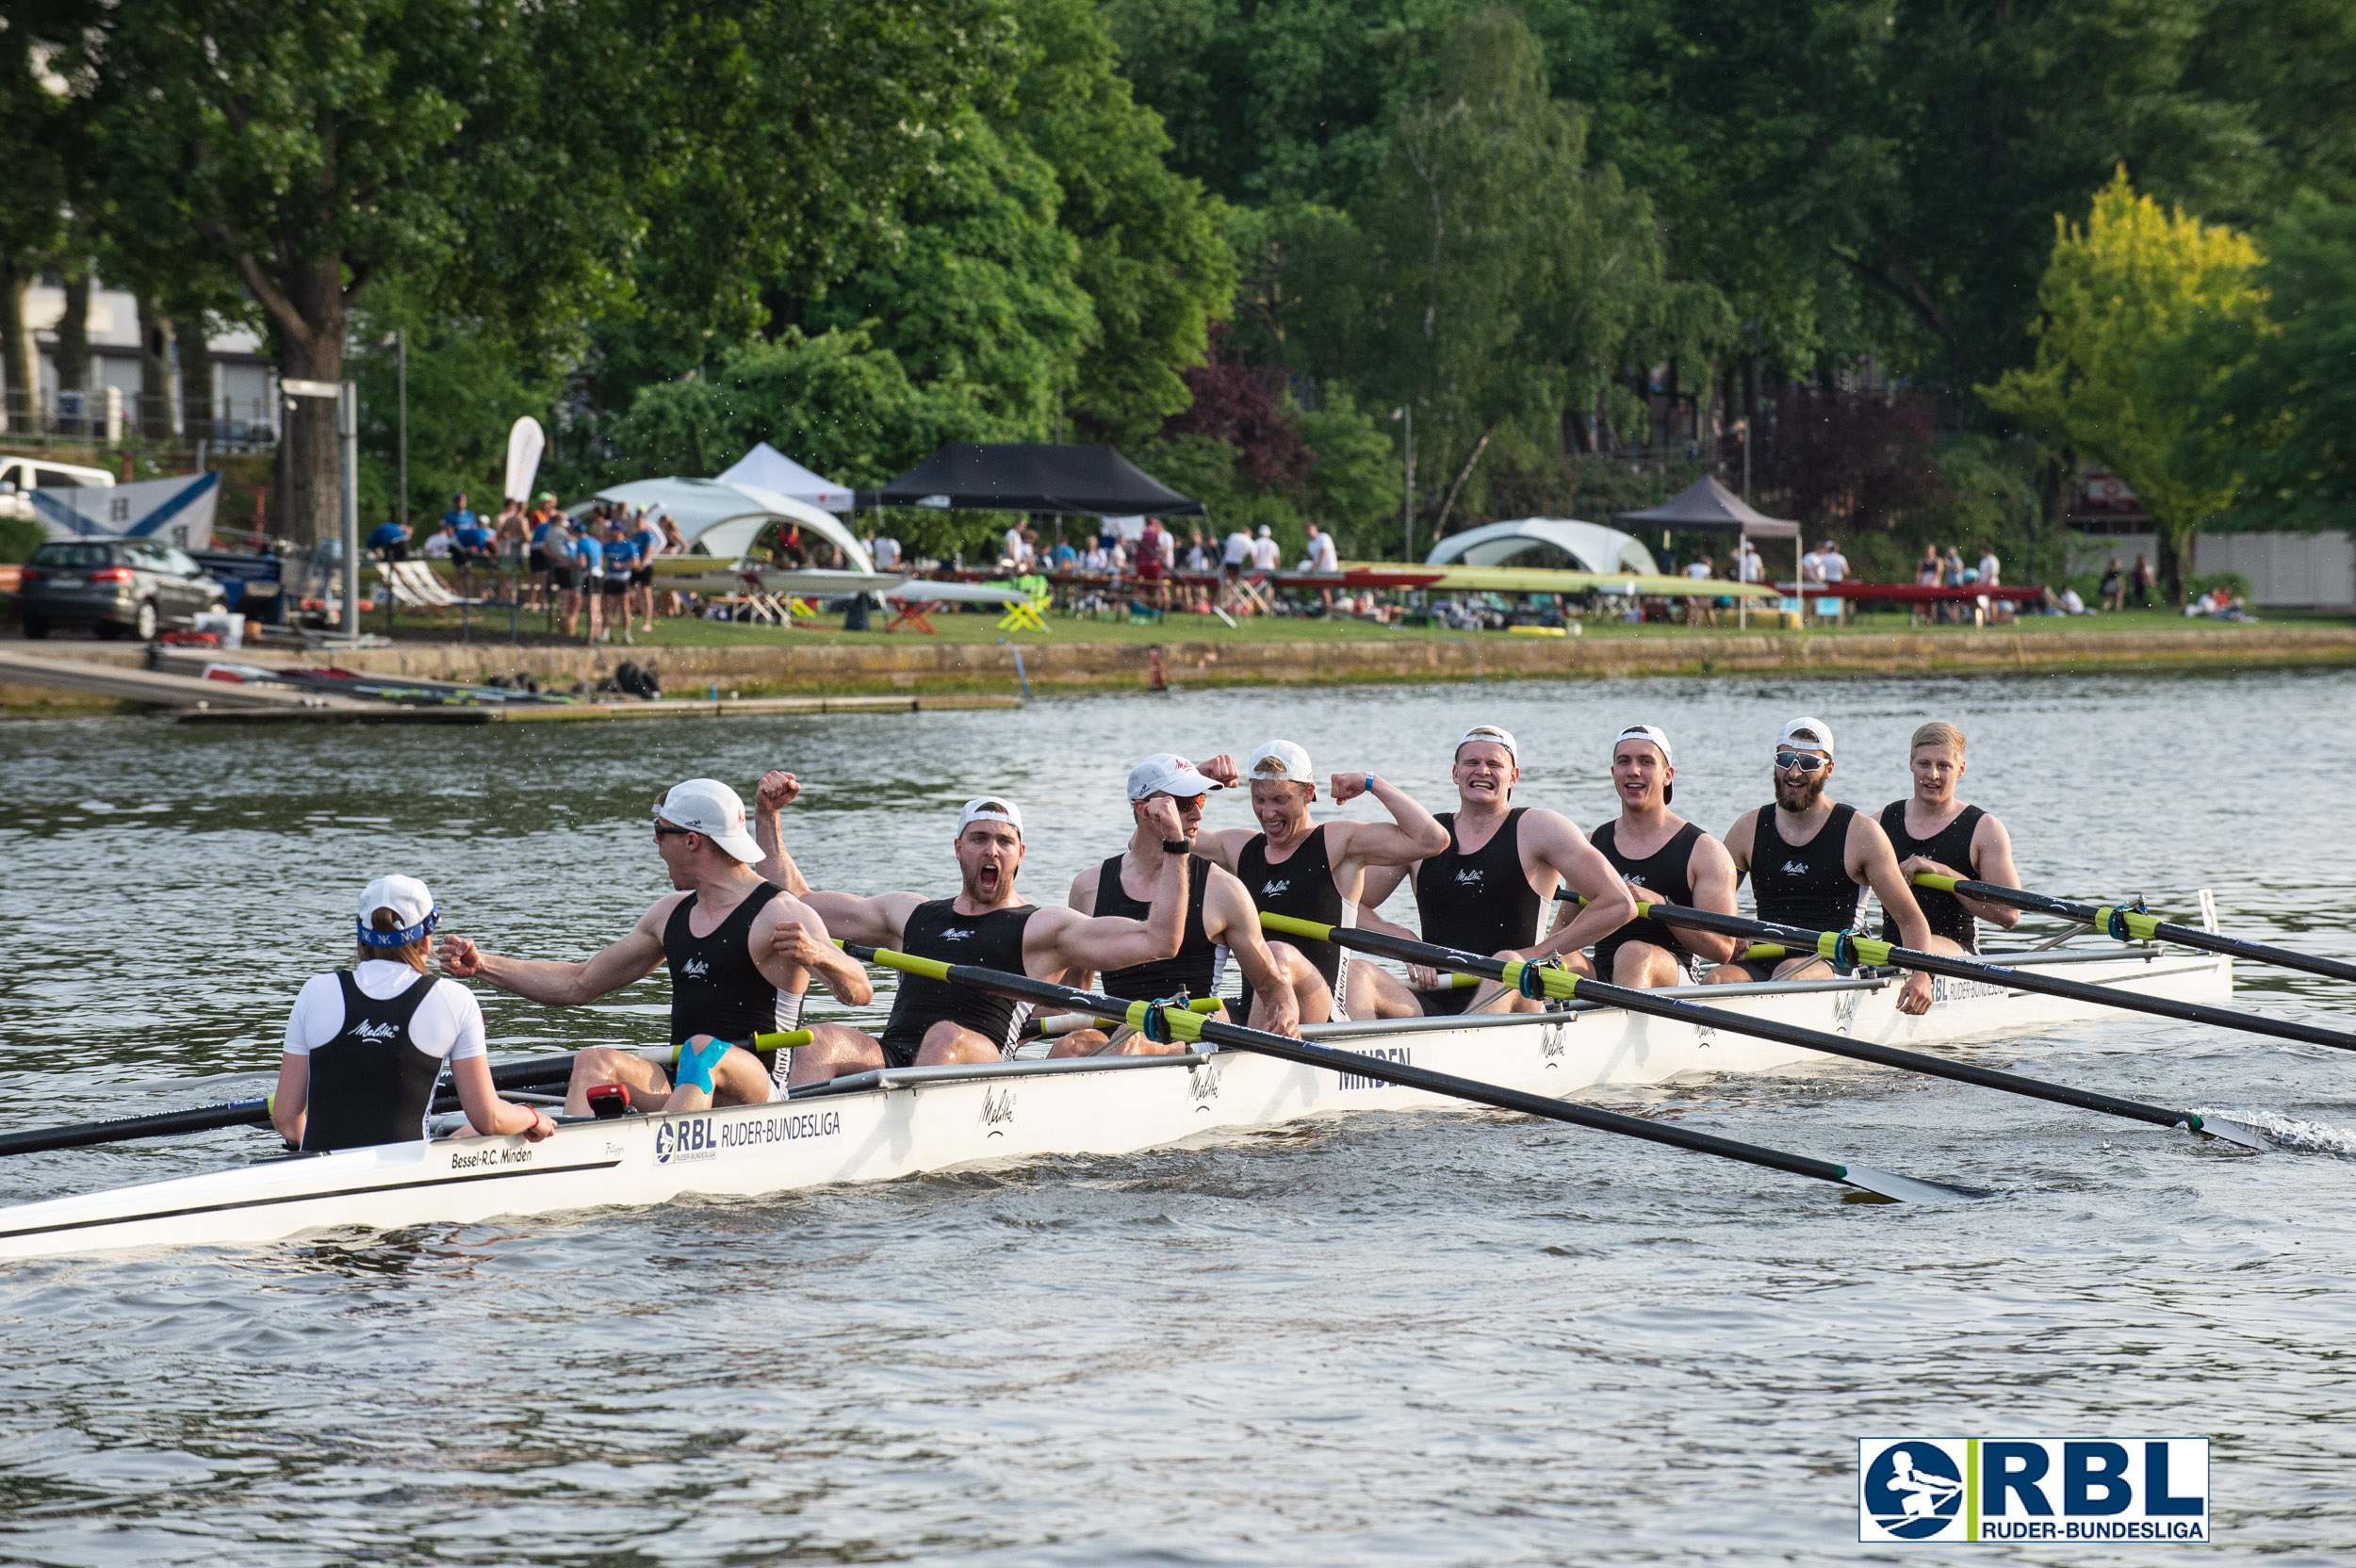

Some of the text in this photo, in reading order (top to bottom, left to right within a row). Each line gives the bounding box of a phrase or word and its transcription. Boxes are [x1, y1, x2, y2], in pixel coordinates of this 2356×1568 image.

[377, 934, 391, 944] NK
[401, 929, 415, 942] NK
[347, 1019, 396, 1038] Melitta
[1538, 1024, 1564, 1061] Melitta
[1186, 1066, 1219, 1102] Melitta
[977, 1085, 1014, 1128] Melitta
[677, 1118, 716, 1152] RBL
[722, 1111, 841, 1149] RUDER-BUNDESLIGA
[451, 1147, 532, 1169] Bessel-R.C. Minden
